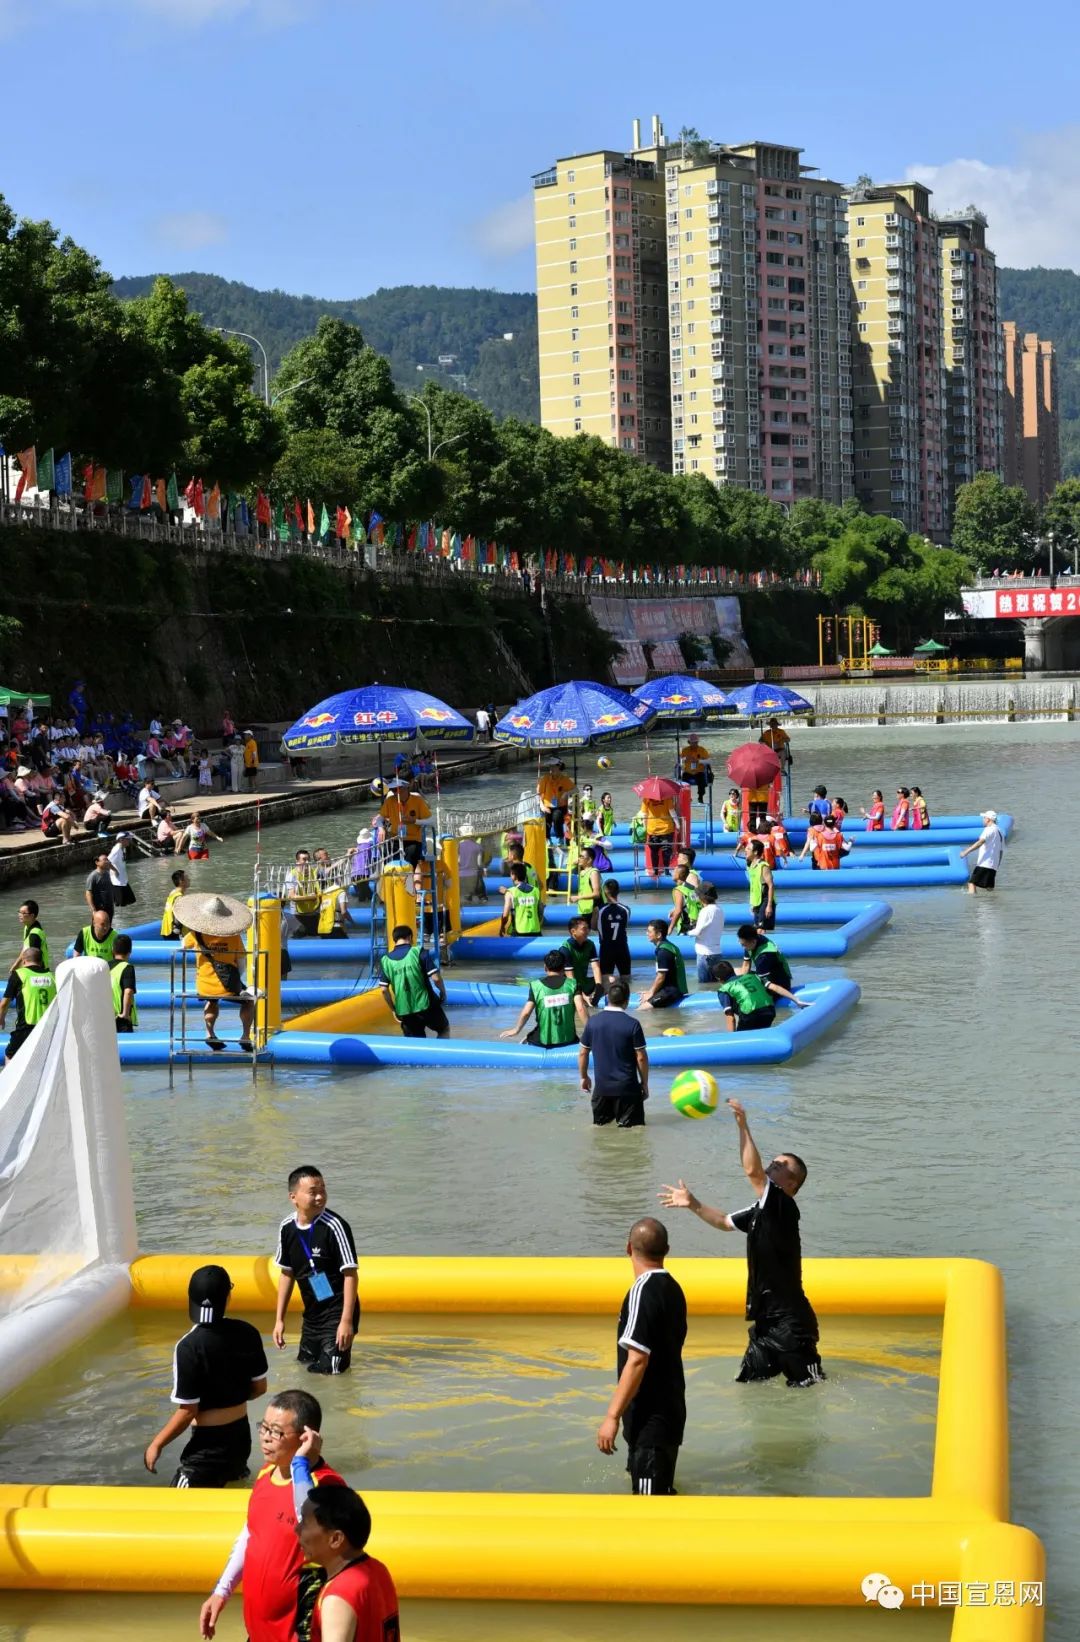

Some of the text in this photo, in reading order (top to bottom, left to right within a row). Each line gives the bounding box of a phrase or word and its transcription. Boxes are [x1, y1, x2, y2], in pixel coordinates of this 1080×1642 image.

[999, 592, 1080, 613] 热烈祝贺2
[354, 711, 398, 725] 红牛
[544, 719, 577, 732] 红牛
[610, 922, 620, 941] 7
[38, 988, 49, 1005] 3
